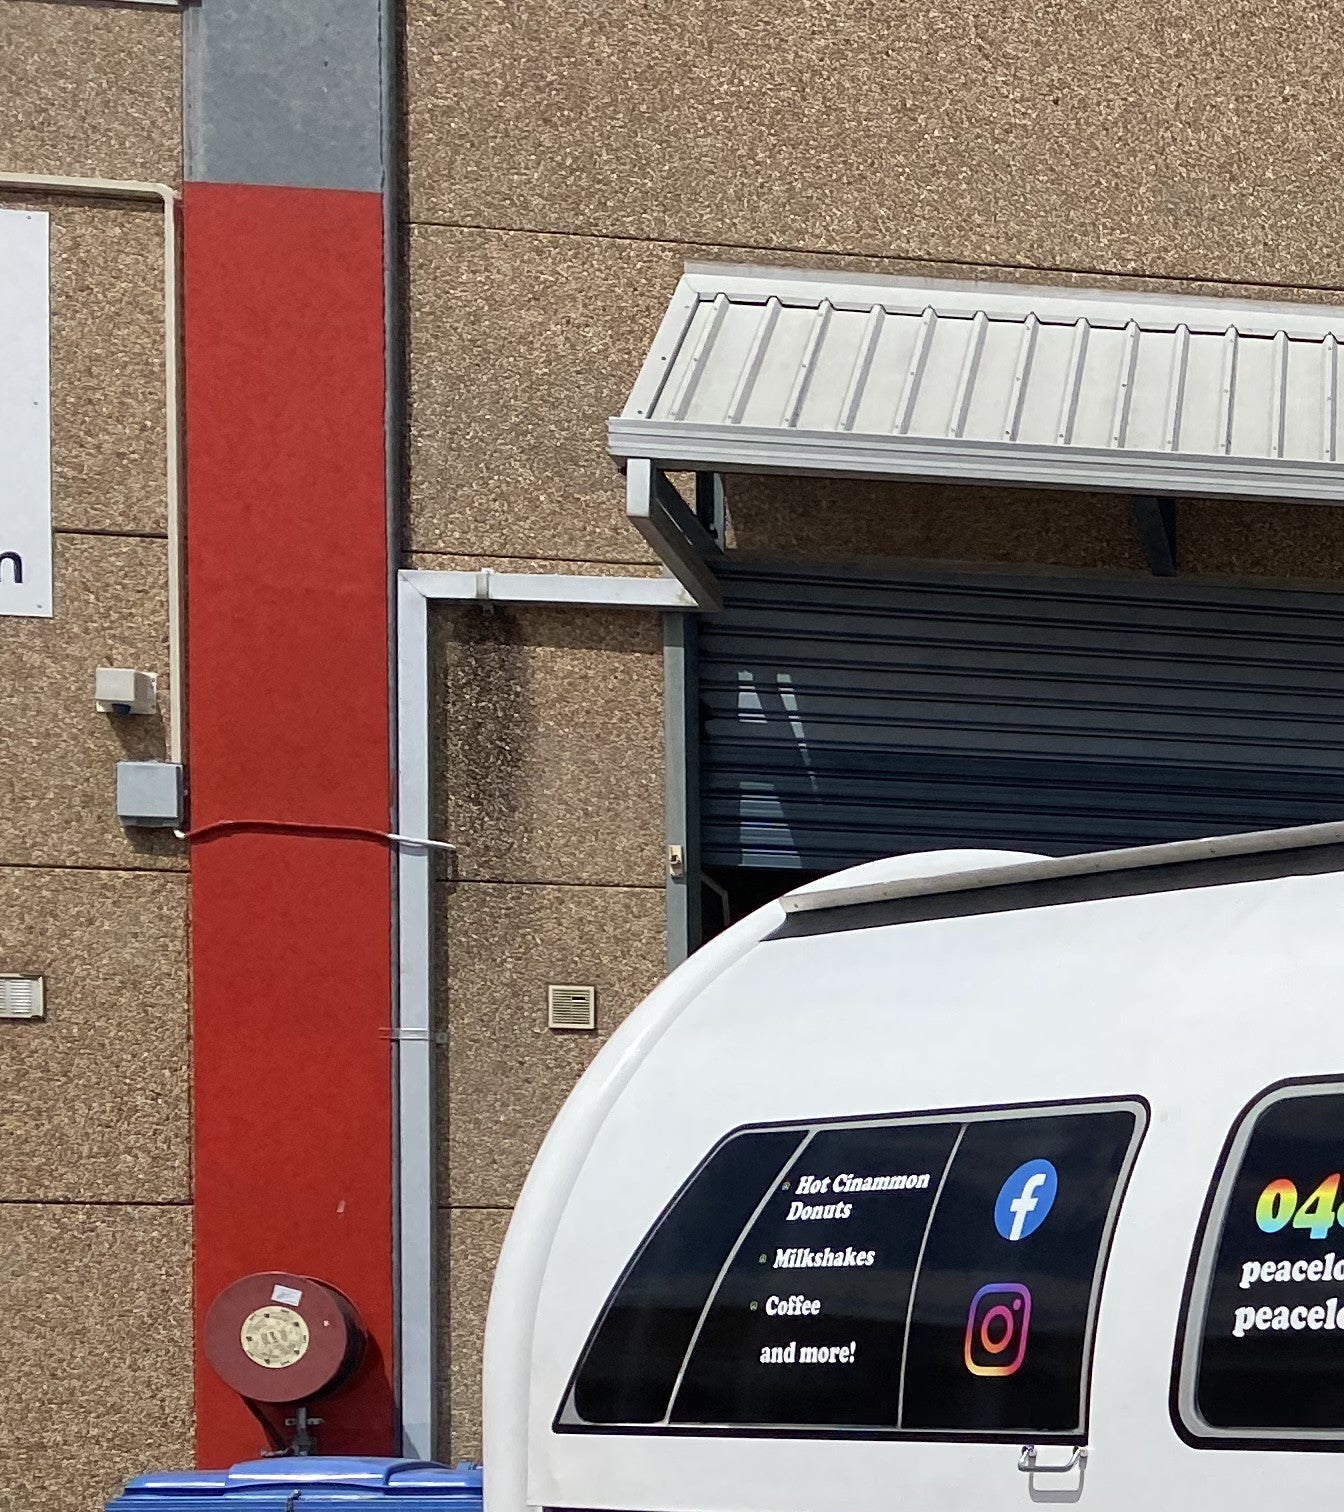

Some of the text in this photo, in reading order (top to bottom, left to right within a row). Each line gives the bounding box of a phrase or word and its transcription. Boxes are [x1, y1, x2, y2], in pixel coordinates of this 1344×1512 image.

[796, 1170, 930, 1195] Hot Cinammon
[786, 1200, 852, 1222] Donuts
[773, 1246, 875, 1269] Milkshakes
[765, 1295, 821, 1317] Coffee
[760, 1341, 857, 1365] and more!
